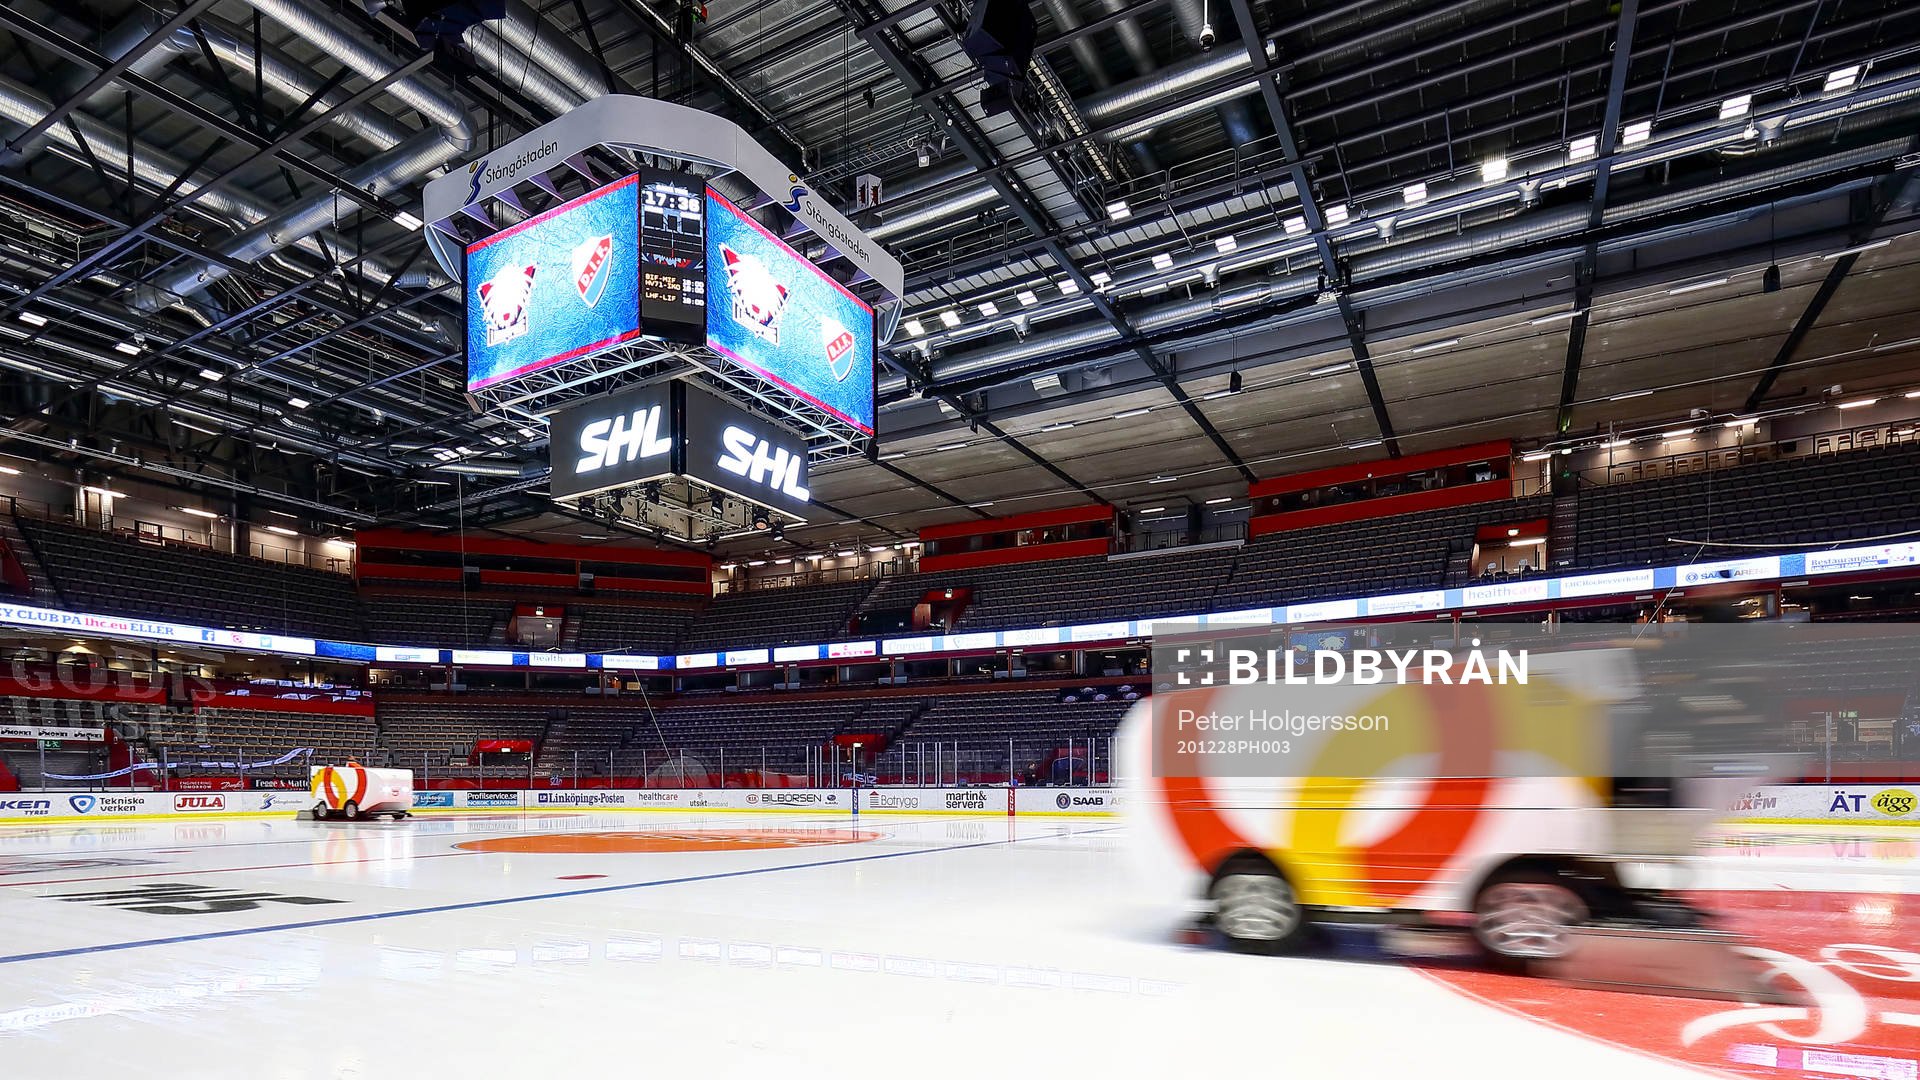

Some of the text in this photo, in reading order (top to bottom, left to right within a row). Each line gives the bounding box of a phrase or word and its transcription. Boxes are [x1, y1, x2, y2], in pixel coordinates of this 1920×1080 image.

[485, 139, 558, 184] Stångåstaden
[805, 200, 871, 264] Stångåstaden
[575, 405, 672, 474] SHL
[716, 425, 810, 503] SHL
[1468, 585, 1542, 601] healthcare
[17, 610, 60, 623] CLUB
[130, 622, 175, 636] ELLER
[99, 796, 145, 805] Tekniska
[176, 797, 223, 808] JULA
[467, 792, 518, 800] Profilservice.se
[638, 792, 679, 801] healthcare
[881, 794, 919, 808] Botrygg
[1072, 797, 1104, 806] SAAB
[1829, 790, 1867, 813] ÄT
[1876, 793, 1914, 813] ägg
[100, 804, 136, 812] verken
[945, 800, 984, 809] servera
